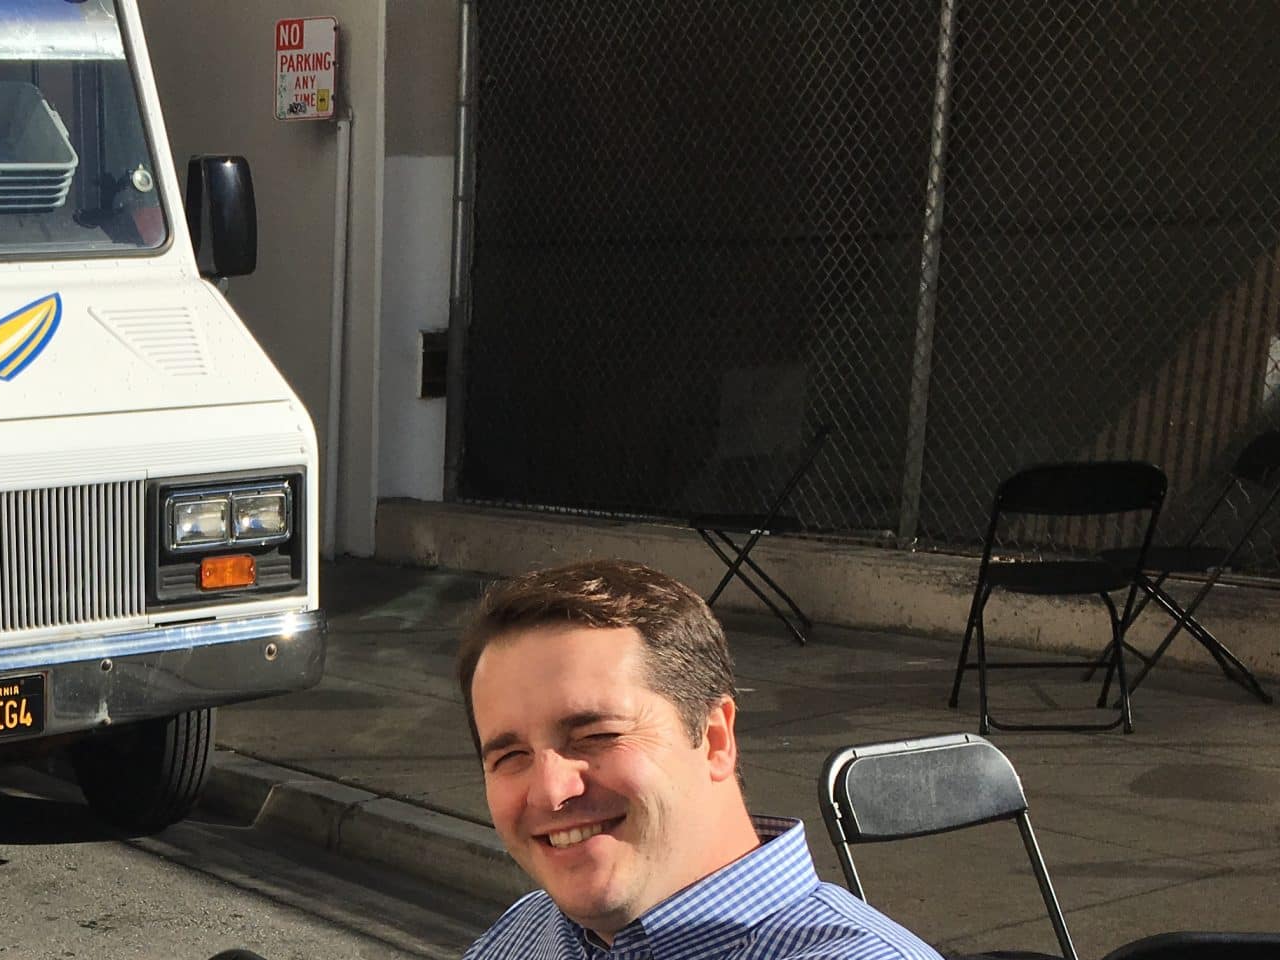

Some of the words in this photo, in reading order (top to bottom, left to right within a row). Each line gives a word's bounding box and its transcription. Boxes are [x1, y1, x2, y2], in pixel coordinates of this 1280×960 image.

[279, 24, 300, 46] NO
[280, 51, 331, 73] PARKING
[294, 75, 317, 90] ANY
[294, 93, 317, 107] TIME
